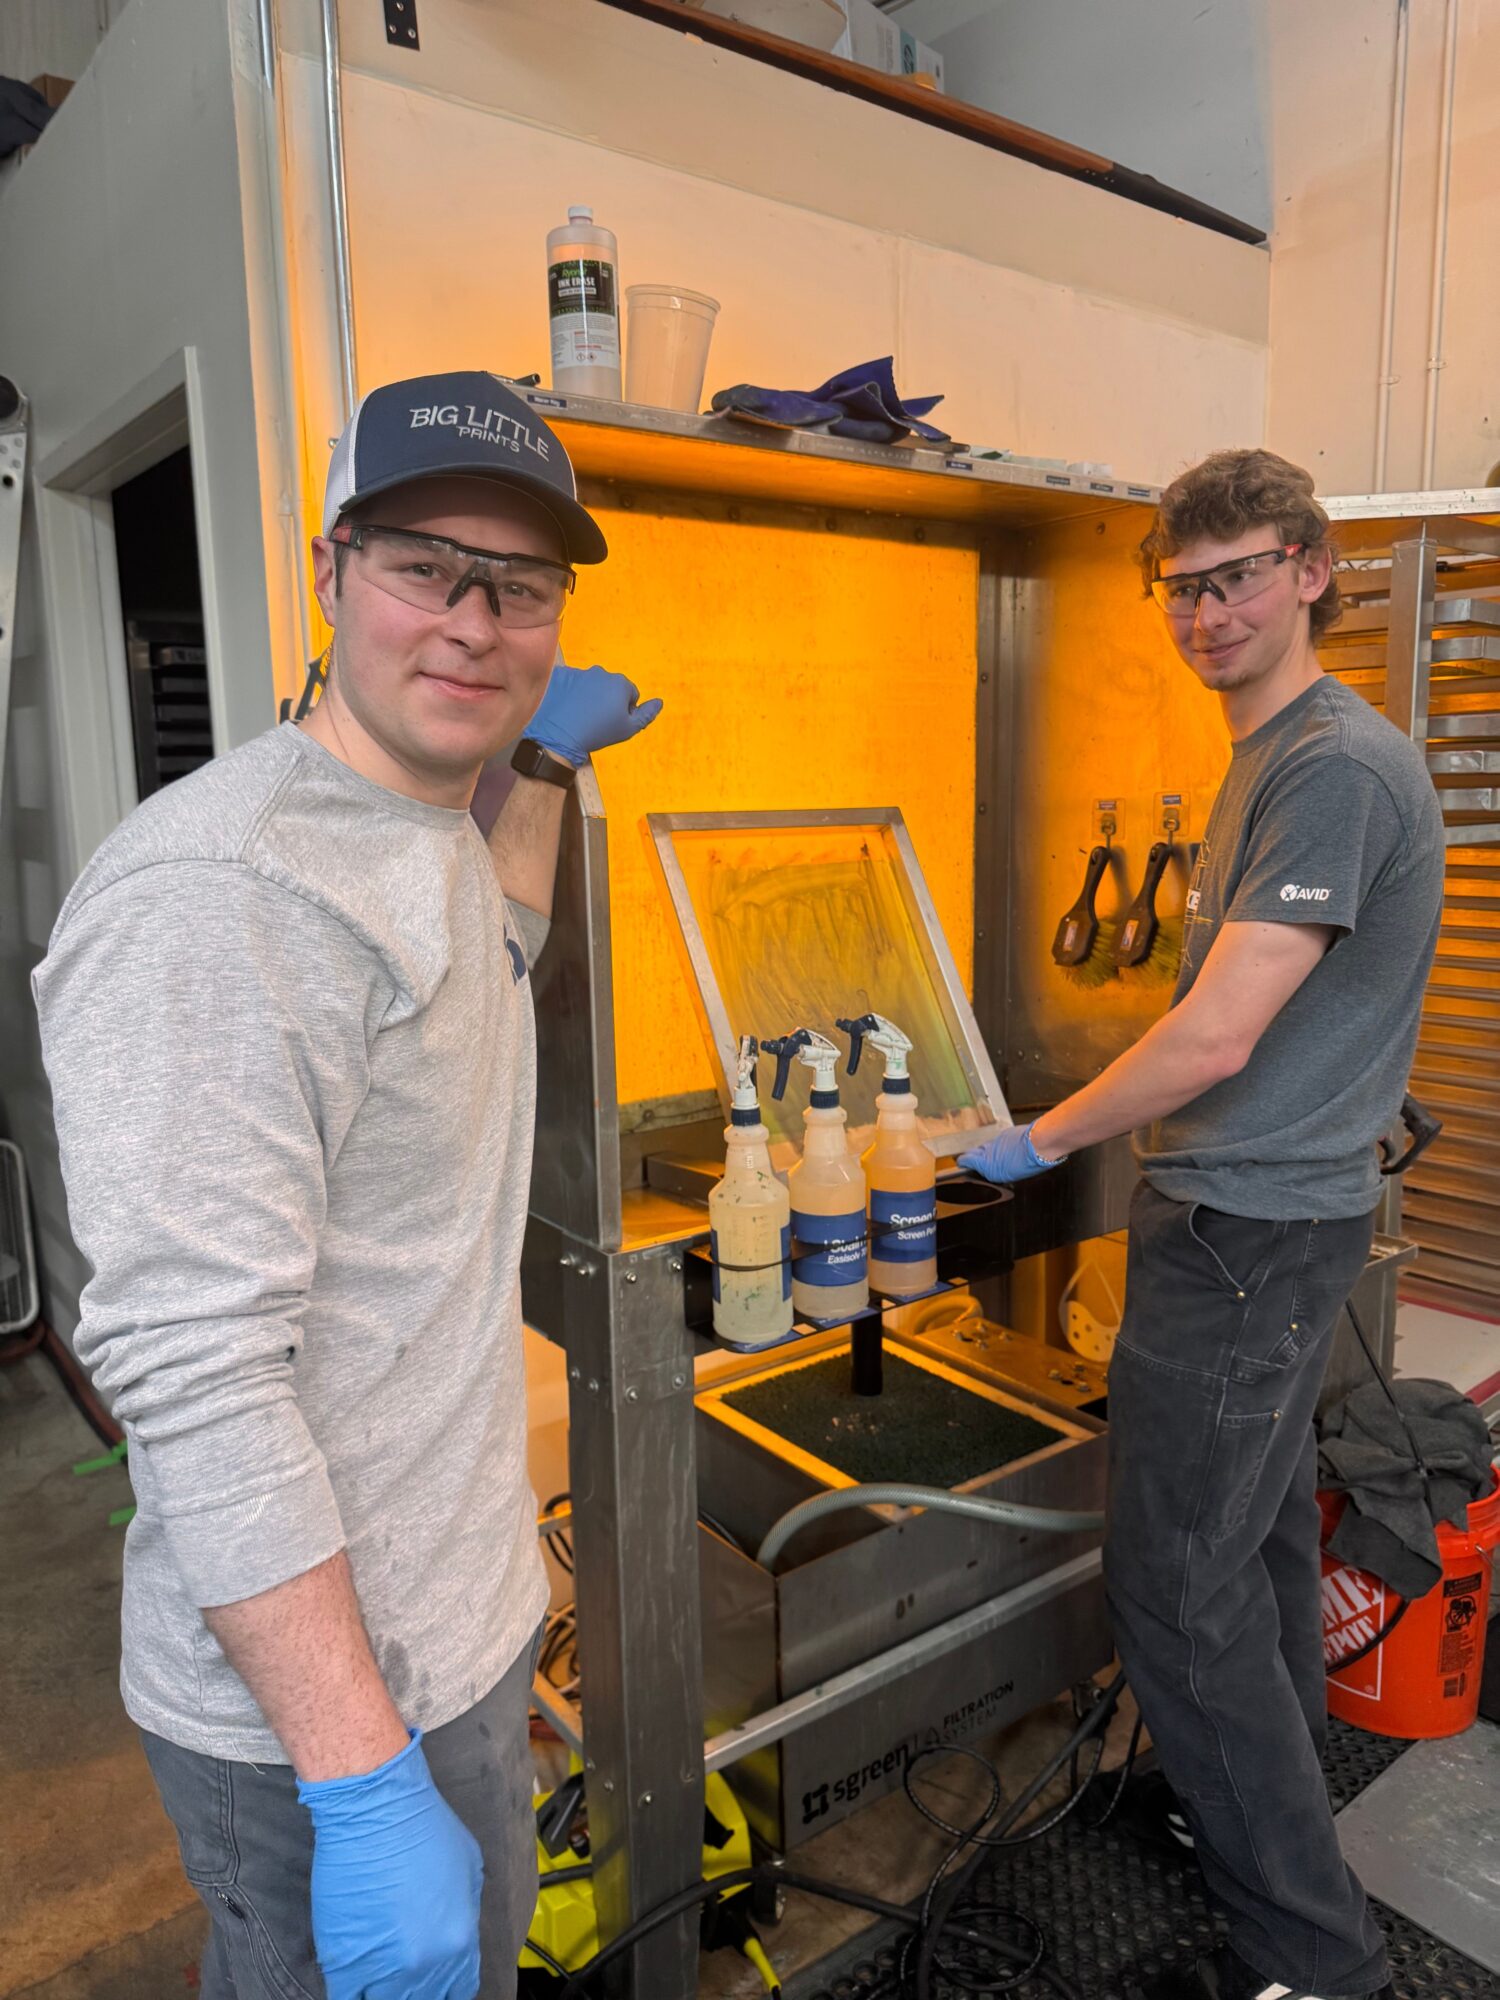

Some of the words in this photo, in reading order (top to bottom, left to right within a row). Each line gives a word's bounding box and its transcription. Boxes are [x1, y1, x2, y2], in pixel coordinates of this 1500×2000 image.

[557, 278, 571, 288] INK
[409, 405, 459, 428] BIG
[465, 405, 550, 462] LITTLE
[456, 425, 520, 453] PRINTS
[1296, 888, 1330, 901] AVID
[897, 1229, 926, 1240] Screen
[943, 1680, 1014, 1729] FILTRATION
[833, 1744, 910, 1802] sgreen
